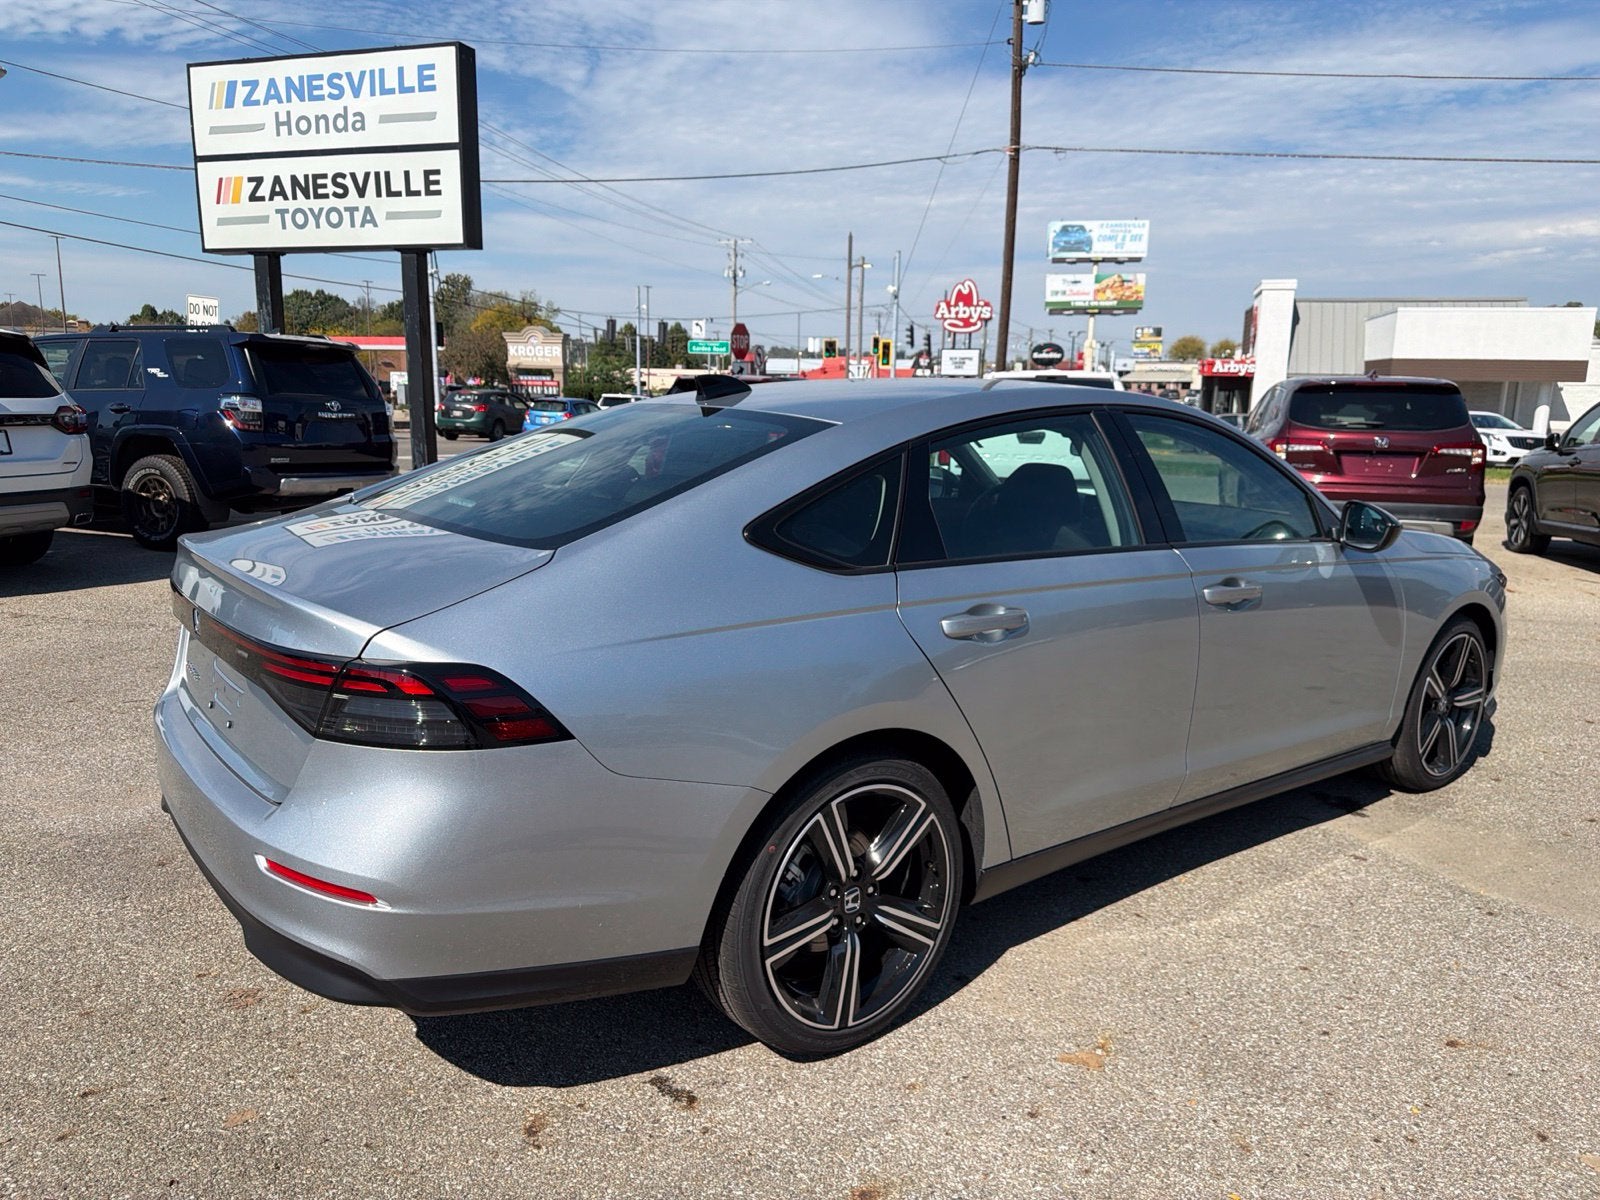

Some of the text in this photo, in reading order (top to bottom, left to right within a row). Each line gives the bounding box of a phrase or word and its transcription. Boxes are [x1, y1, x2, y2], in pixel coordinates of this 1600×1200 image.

[241, 63, 438, 107] ZANESVILLE
[274, 106, 366, 137] Honda
[247, 168, 442, 203] ZANESVILLE
[275, 206, 379, 230] TOYOTA
[189, 303, 218, 317] DO NOT
[935, 301, 993, 323] Arby's
[509, 345, 560, 357] KROGER
[732, 334, 748, 349] STOP
